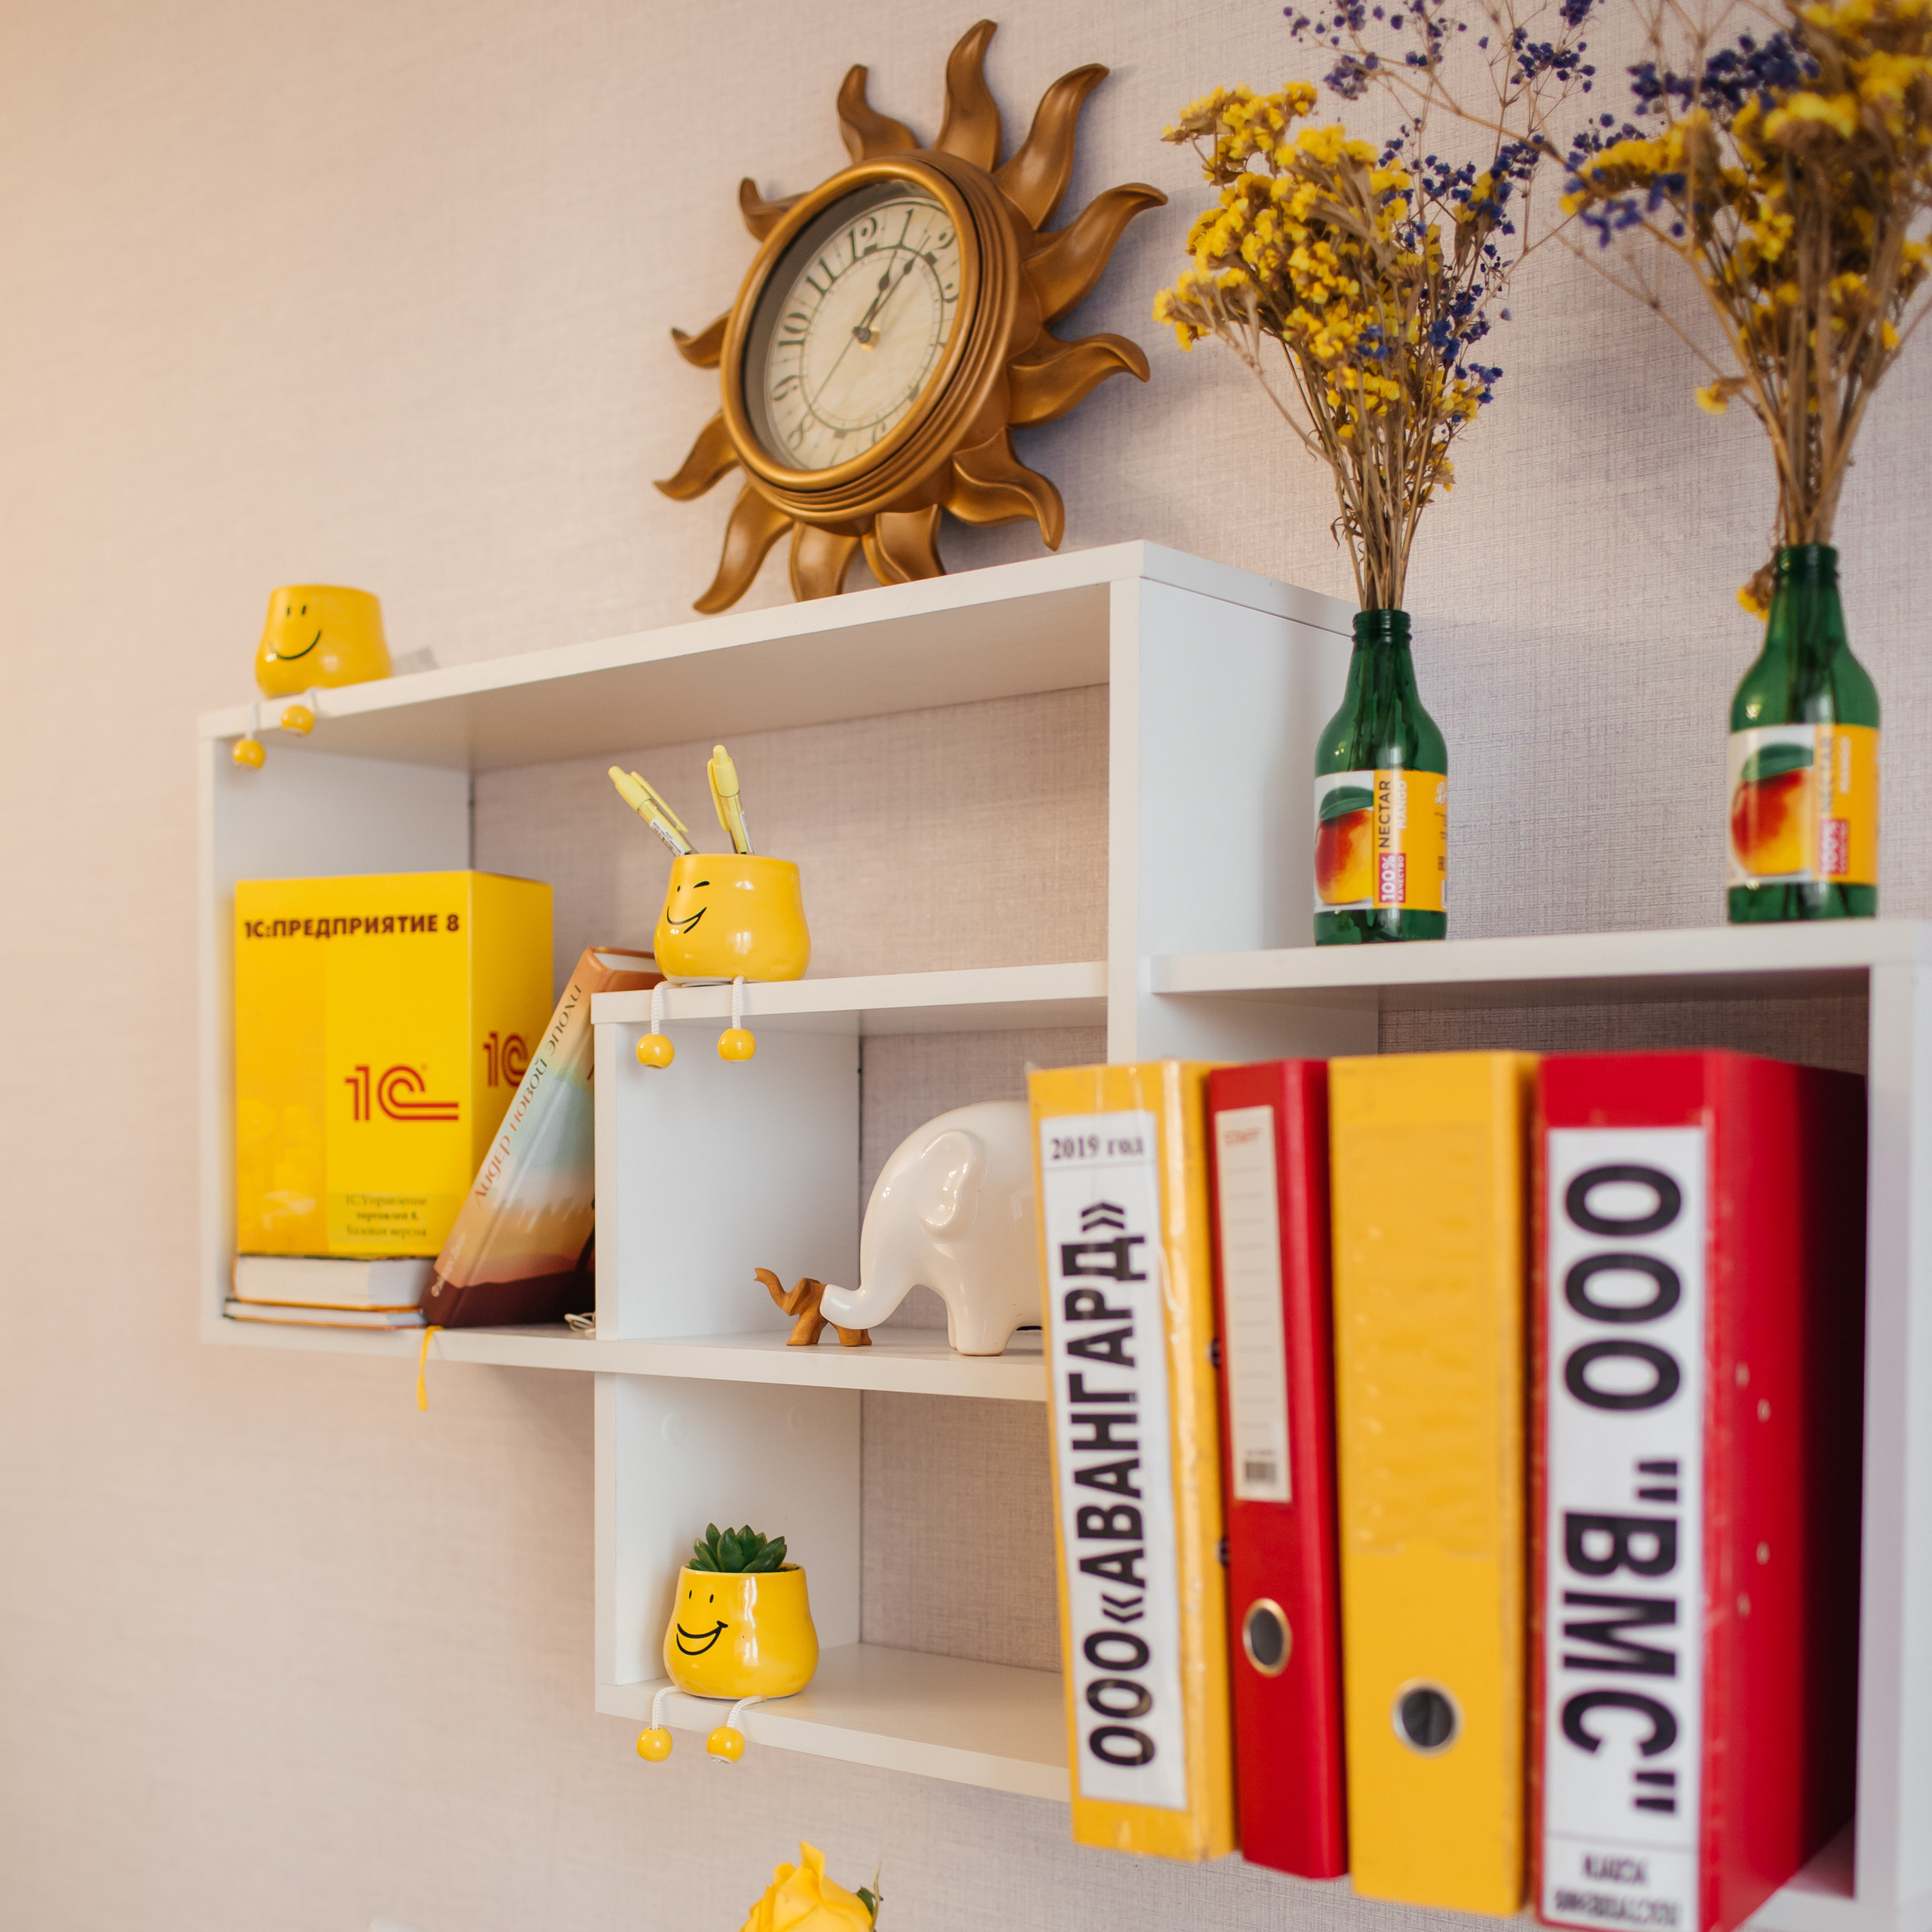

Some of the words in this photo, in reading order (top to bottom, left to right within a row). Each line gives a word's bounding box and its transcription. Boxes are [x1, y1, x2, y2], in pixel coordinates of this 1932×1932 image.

[1378, 780, 1391, 848] NECTAR
[1396, 780, 1407, 829] MANGO
[1381, 854, 1395, 902] 100%
[1396, 855, 1404, 902] КАЧЕСТВО
[245, 914, 438, 940] 1С:ПРЕДПРИЯТИЕ
[446, 914, 460, 932] 8
[1051, 1134, 1100, 1161] 2019
[1107, 1136, 1145, 1157] год
[1563, 1162, 1684, 1414] ООО
[1560, 1458, 1681, 1816] "ВМС"
